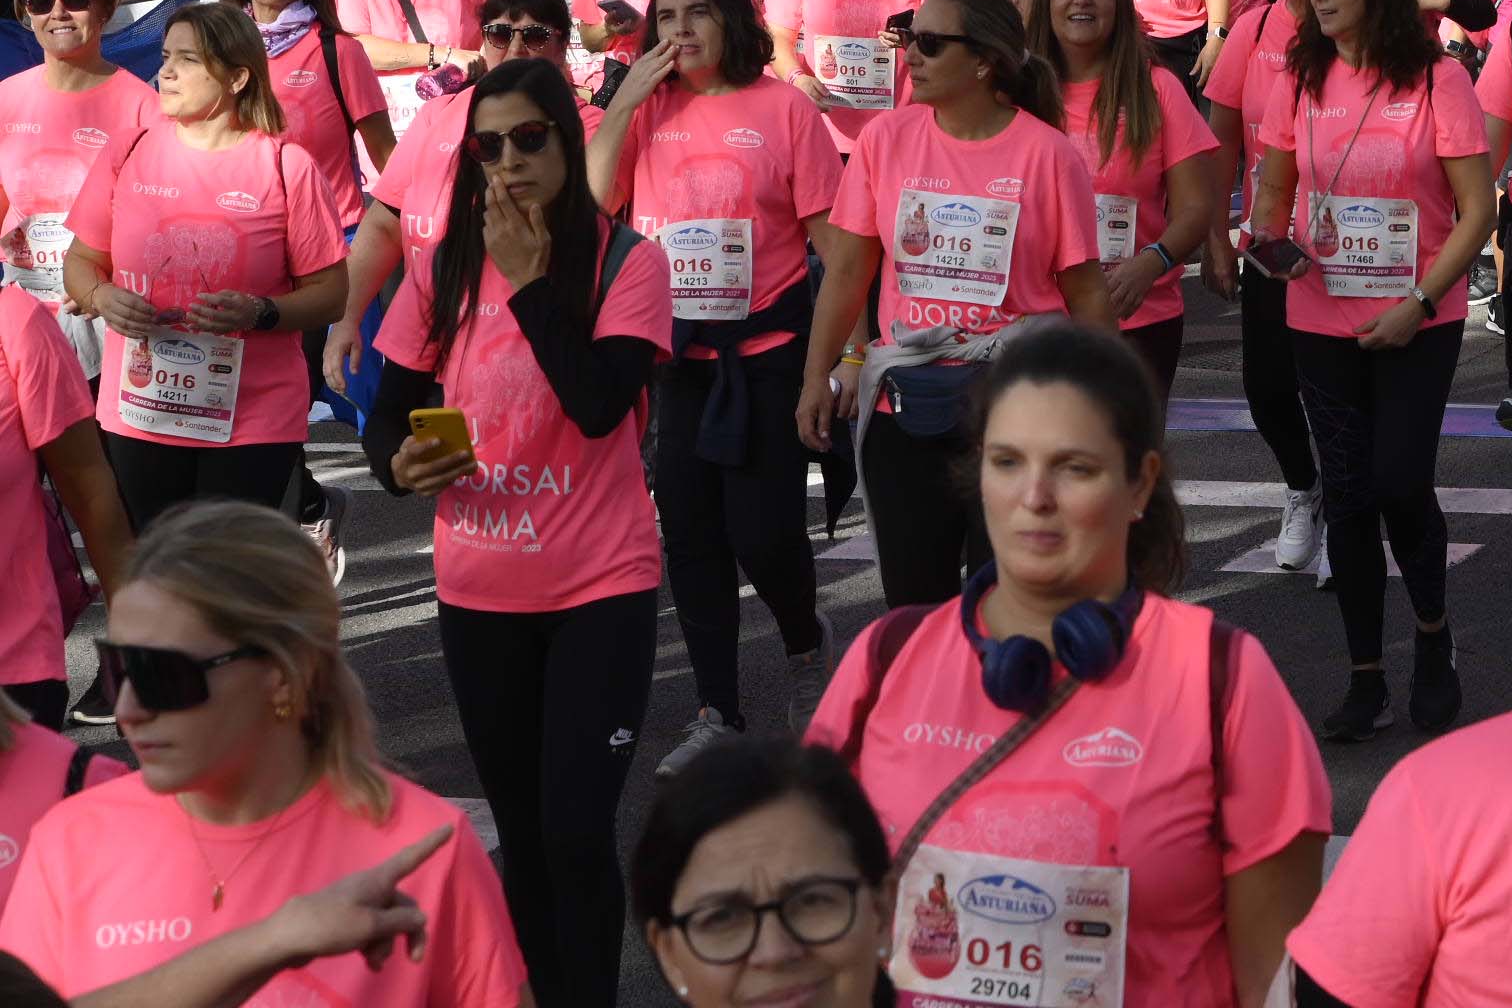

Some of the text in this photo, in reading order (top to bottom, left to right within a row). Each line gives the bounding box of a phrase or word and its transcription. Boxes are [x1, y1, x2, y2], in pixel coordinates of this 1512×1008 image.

[840, 65, 867, 77] 016
[1306, 107, 1347, 119] OYSHO
[904, 176, 951, 190] OYSHO
[132, 183, 180, 199] OYSHO
[935, 210, 978, 223] ASTURIANA
[1340, 212, 1381, 224] ASTURIANA
[671, 236, 715, 246] ASTURIANA
[933, 234, 973, 252] 016
[1342, 236, 1379, 251] 016
[673, 258, 713, 273] 016
[935, 255, 966, 267] 14212
[1346, 254, 1374, 264] 17468
[904, 265, 935, 275] CARRERA
[935, 269, 946, 277] DE
[946, 270, 956, 278] LA
[956, 271, 979, 280] MUJER
[119, 269, 147, 297] TU
[678, 277, 708, 286] 14213
[900, 278, 934, 291] OYSHO
[1327, 279, 1347, 289] SHO
[157, 346, 202, 362] ASTURIANA
[155, 369, 196, 389] 016
[156, 389, 188, 403] 14211
[128, 395, 156, 409] CARRERA
[157, 402, 169, 411] DE
[168, 403, 178, 412] LA
[179, 406, 203, 415] MUJER
[125, 408, 156, 424] OYSHO
[184, 420, 223, 433] Santander
[452, 502, 537, 541] SUMA
[521, 543, 542, 553] 2023
[1068, 742, 1138, 763] ASTURIANA
[966, 888, 1049, 915] ASTURIANA
[1065, 893, 1111, 907] SUMA
[95, 917, 193, 949] OYSHO
[966, 937, 1042, 972] 016
[971, 977, 1032, 999] 29704
